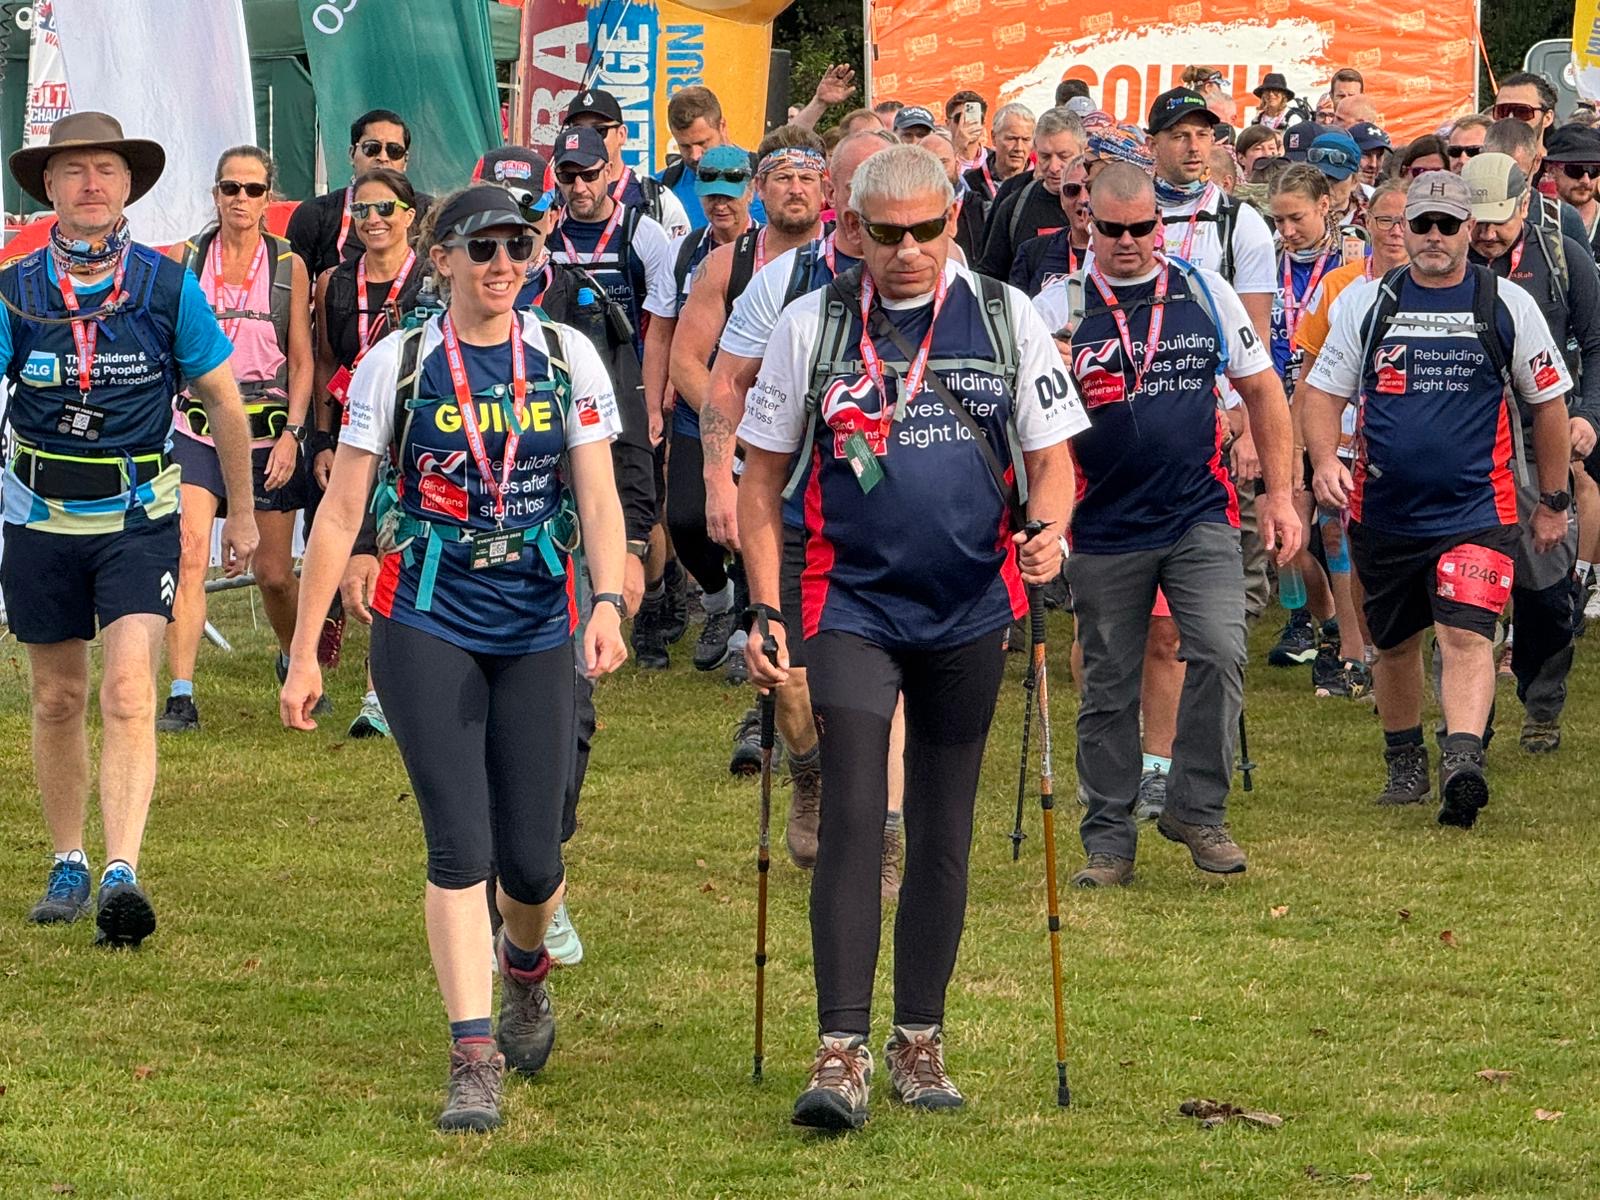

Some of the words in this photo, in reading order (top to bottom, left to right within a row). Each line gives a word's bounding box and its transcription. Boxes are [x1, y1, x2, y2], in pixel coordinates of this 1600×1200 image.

[1392, 313, 1471, 333] ANDY
[138, 351, 147, 361] &
[1175, 353, 1210, 370] after
[1413, 349, 1484, 366] Rebuilding
[103, 363, 148, 377] People's
[109, 370, 162, 385] Association
[1413, 363, 1442, 376] lives
[1444, 364, 1476, 378] after
[1179, 375, 1203, 390] loss
[1412, 379, 1443, 393] sight
[1446, 380, 1469, 392] loss
[756, 395, 781, 411] after
[754, 407, 773, 425] loss
[898, 423, 953, 449] sight
[479, 478, 519, 495] lies
[522, 474, 550, 493] after
[524, 497, 545, 514] loss
[1459, 562, 1498, 585] 1246
